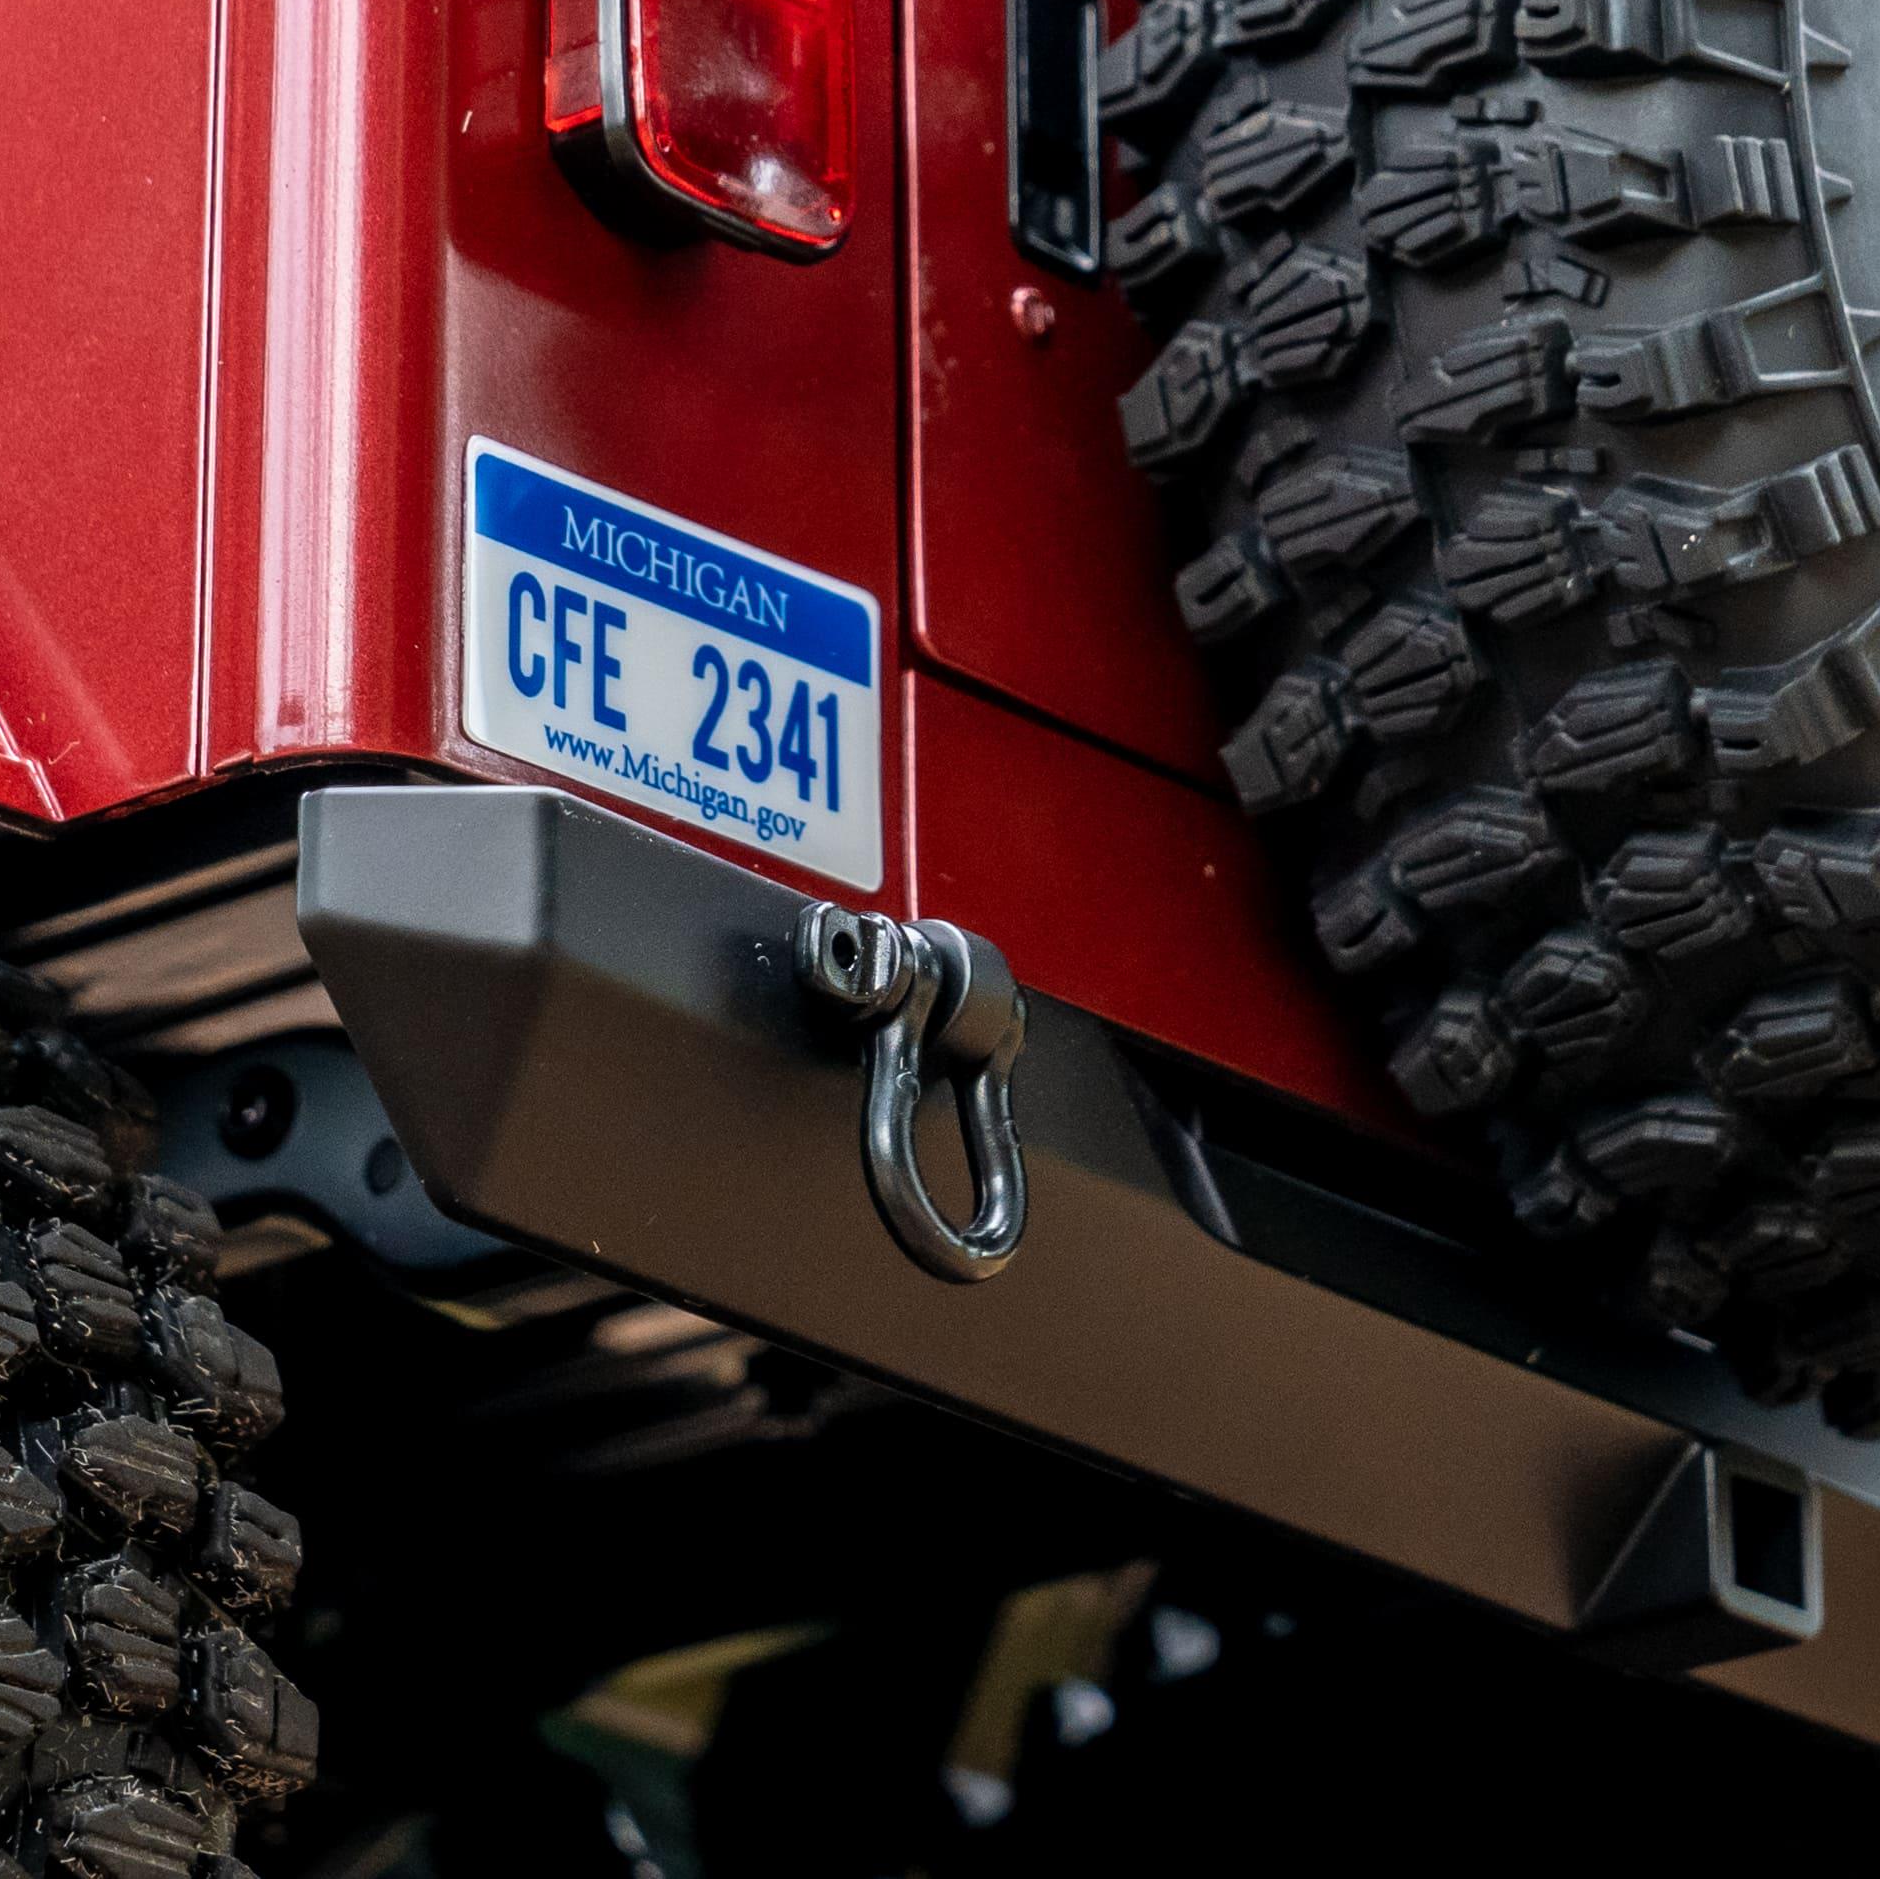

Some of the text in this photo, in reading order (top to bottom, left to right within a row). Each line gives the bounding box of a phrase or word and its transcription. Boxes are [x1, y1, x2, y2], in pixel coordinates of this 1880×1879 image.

[561, 506, 789, 633] MICHIGAN
[508, 570, 840, 813] CFE 2341
[544, 724, 807, 841] www.Michigan.gov
